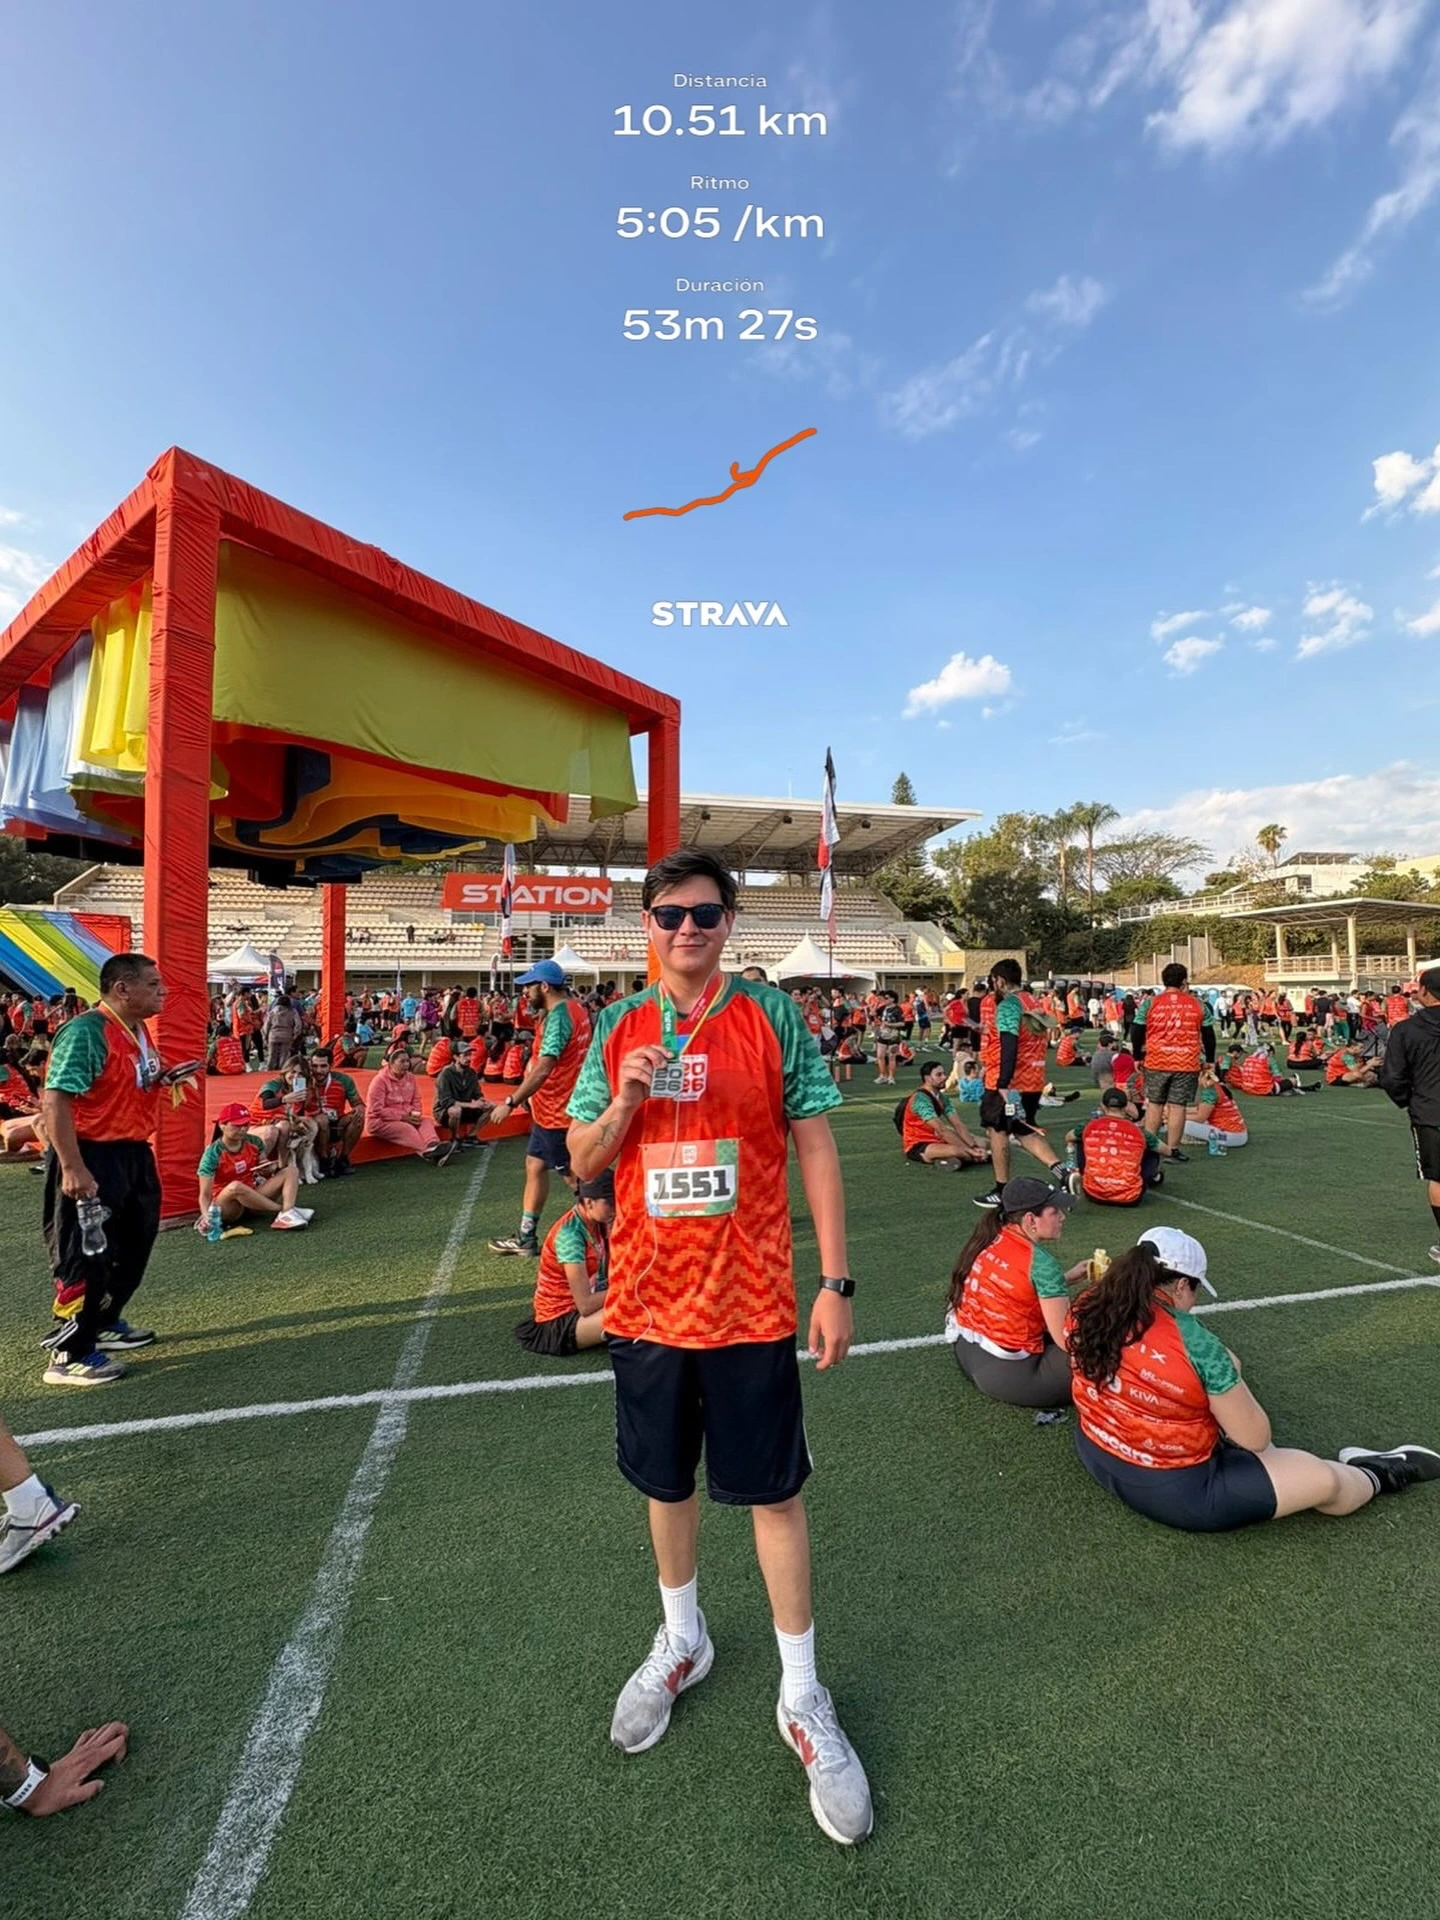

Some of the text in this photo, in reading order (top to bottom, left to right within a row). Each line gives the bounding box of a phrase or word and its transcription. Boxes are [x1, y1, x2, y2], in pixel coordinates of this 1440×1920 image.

[655, 1068, 682, 1079] 20
[653, 1080, 681, 1092] 26
[653, 1169, 731, 1200] 1551
[1129, 1387, 1160, 1405] KIVA
